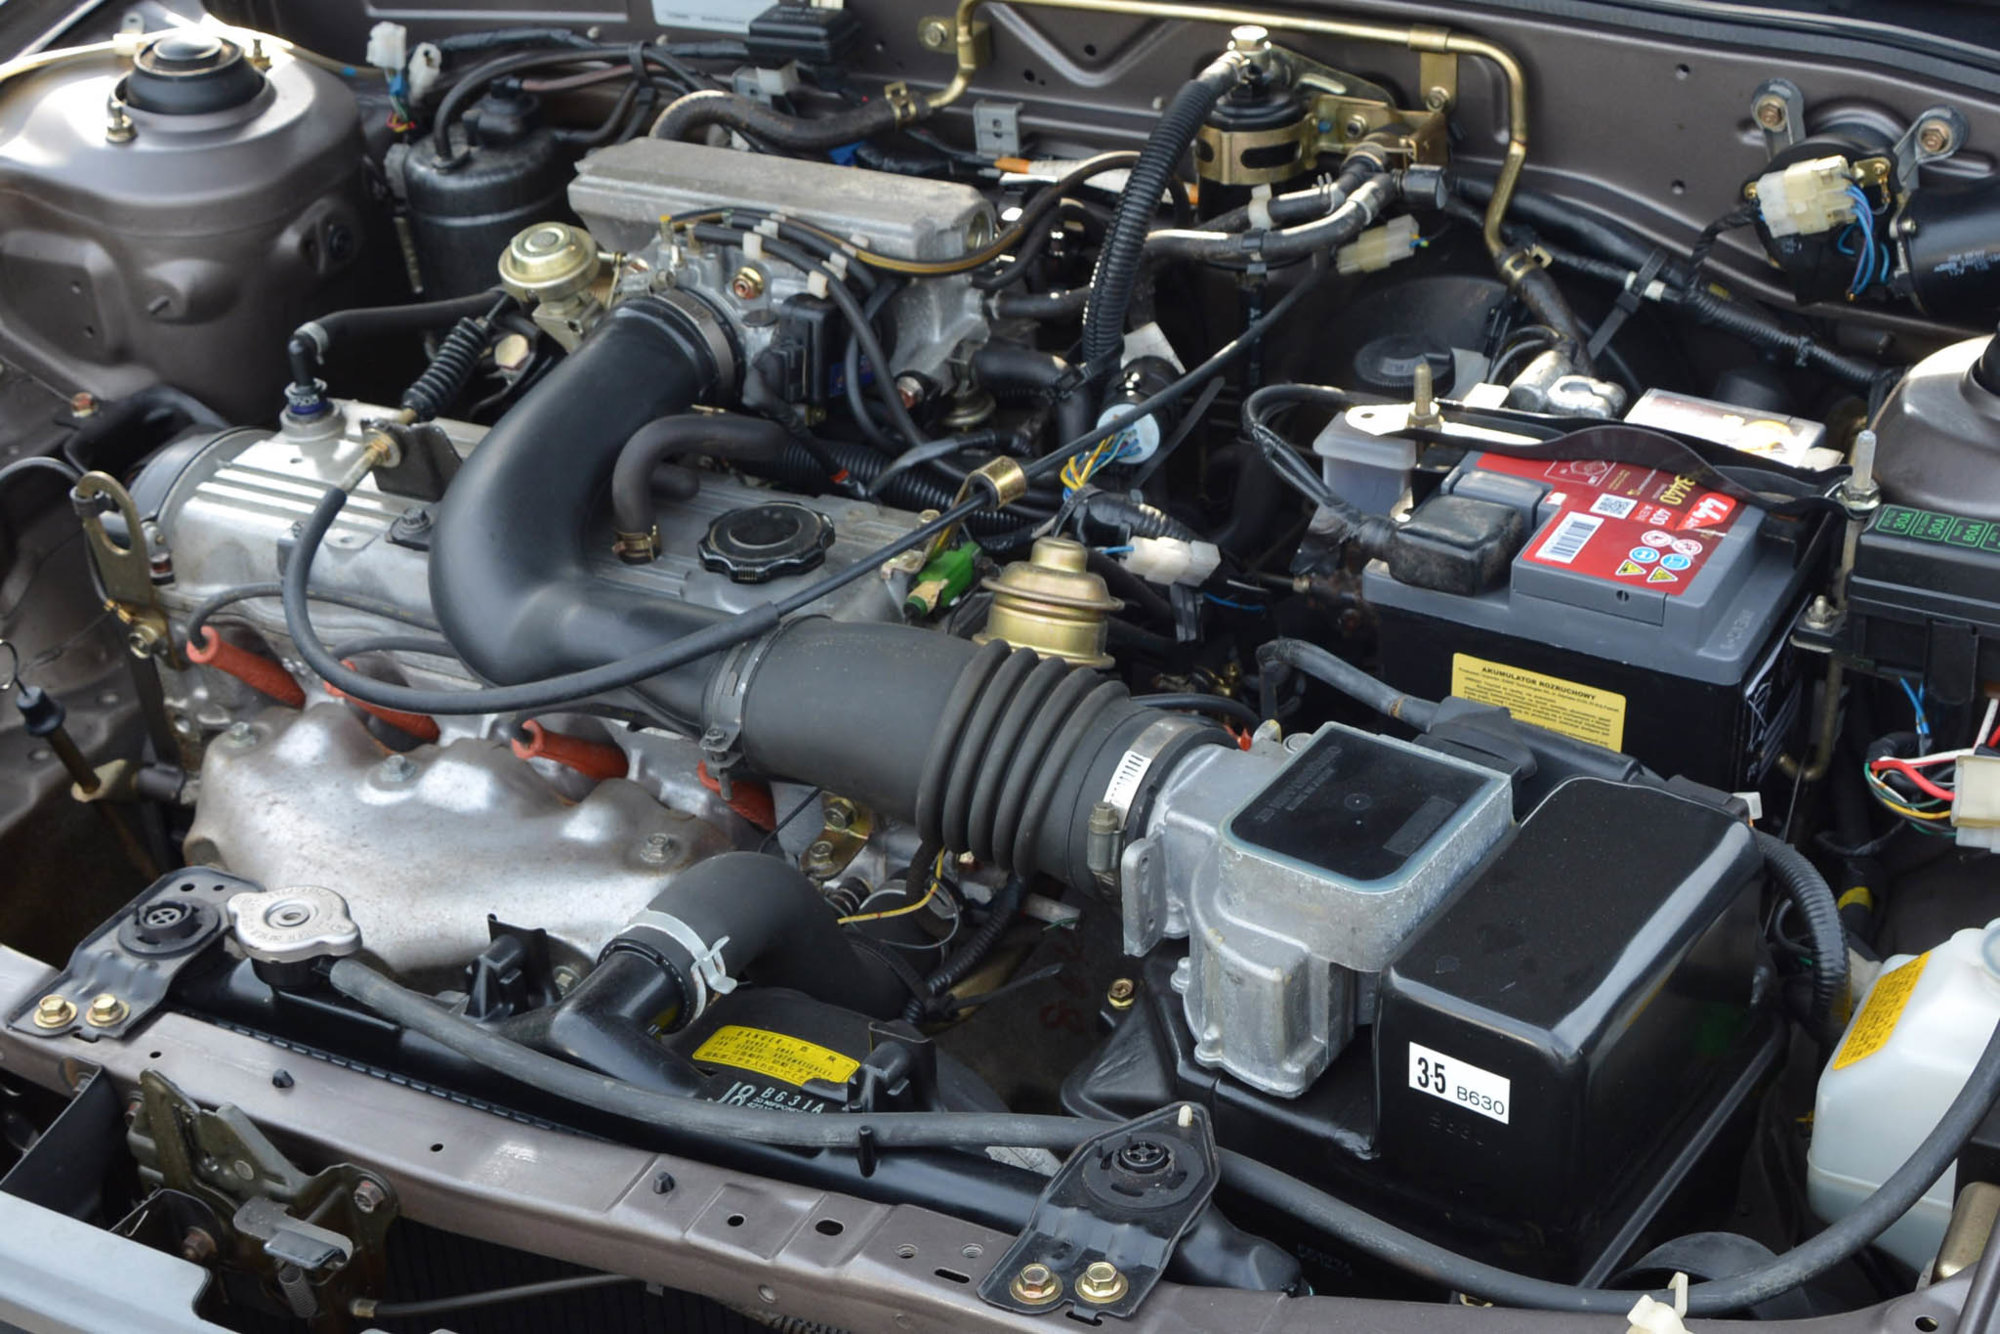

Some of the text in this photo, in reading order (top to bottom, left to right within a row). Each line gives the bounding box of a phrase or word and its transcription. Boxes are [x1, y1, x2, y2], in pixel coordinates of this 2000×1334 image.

[1893, 511, 1914, 530] 30A
[1928, 518, 1949, 536] 30A
[1482, 666, 1596, 700] AKUMULATOR ROZRUCHOWY
[760, 1086, 825, 1114] B631A
[1456, 1085, 1505, 1115] B630
